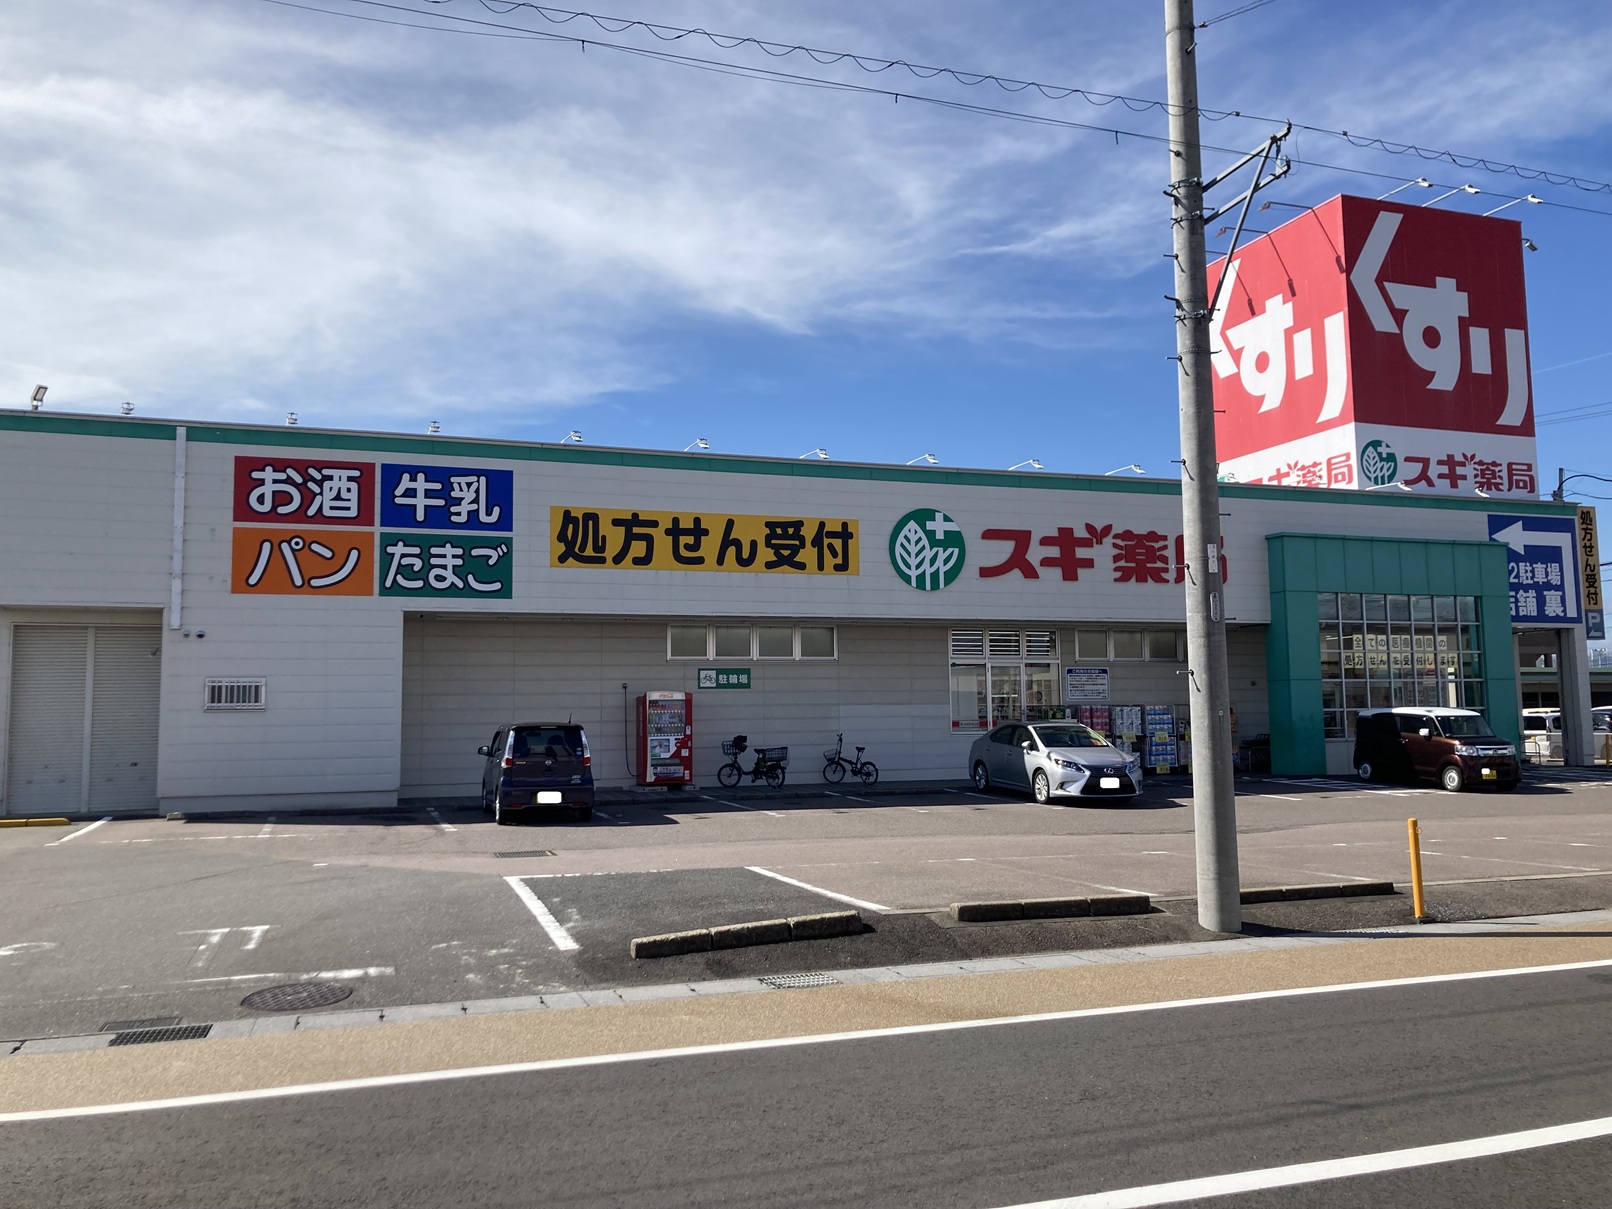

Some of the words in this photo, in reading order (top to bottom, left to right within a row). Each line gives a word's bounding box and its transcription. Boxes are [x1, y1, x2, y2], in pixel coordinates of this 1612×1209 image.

[1209, 258, 1348, 424] くすり
[1350, 211, 1529, 427] くすり
[246, 464, 362, 519] お酒
[393, 472, 501, 526] 牛乳
[1403, 452, 1536, 494] スギ薬局
[246, 536, 360, 590] パン
[384, 539, 508, 593] たまご
[556, 509, 855, 573] 処方せん受付
[1580, 509, 1599, 606] 処方せん受付
[1588, 612, 1601, 627] P
